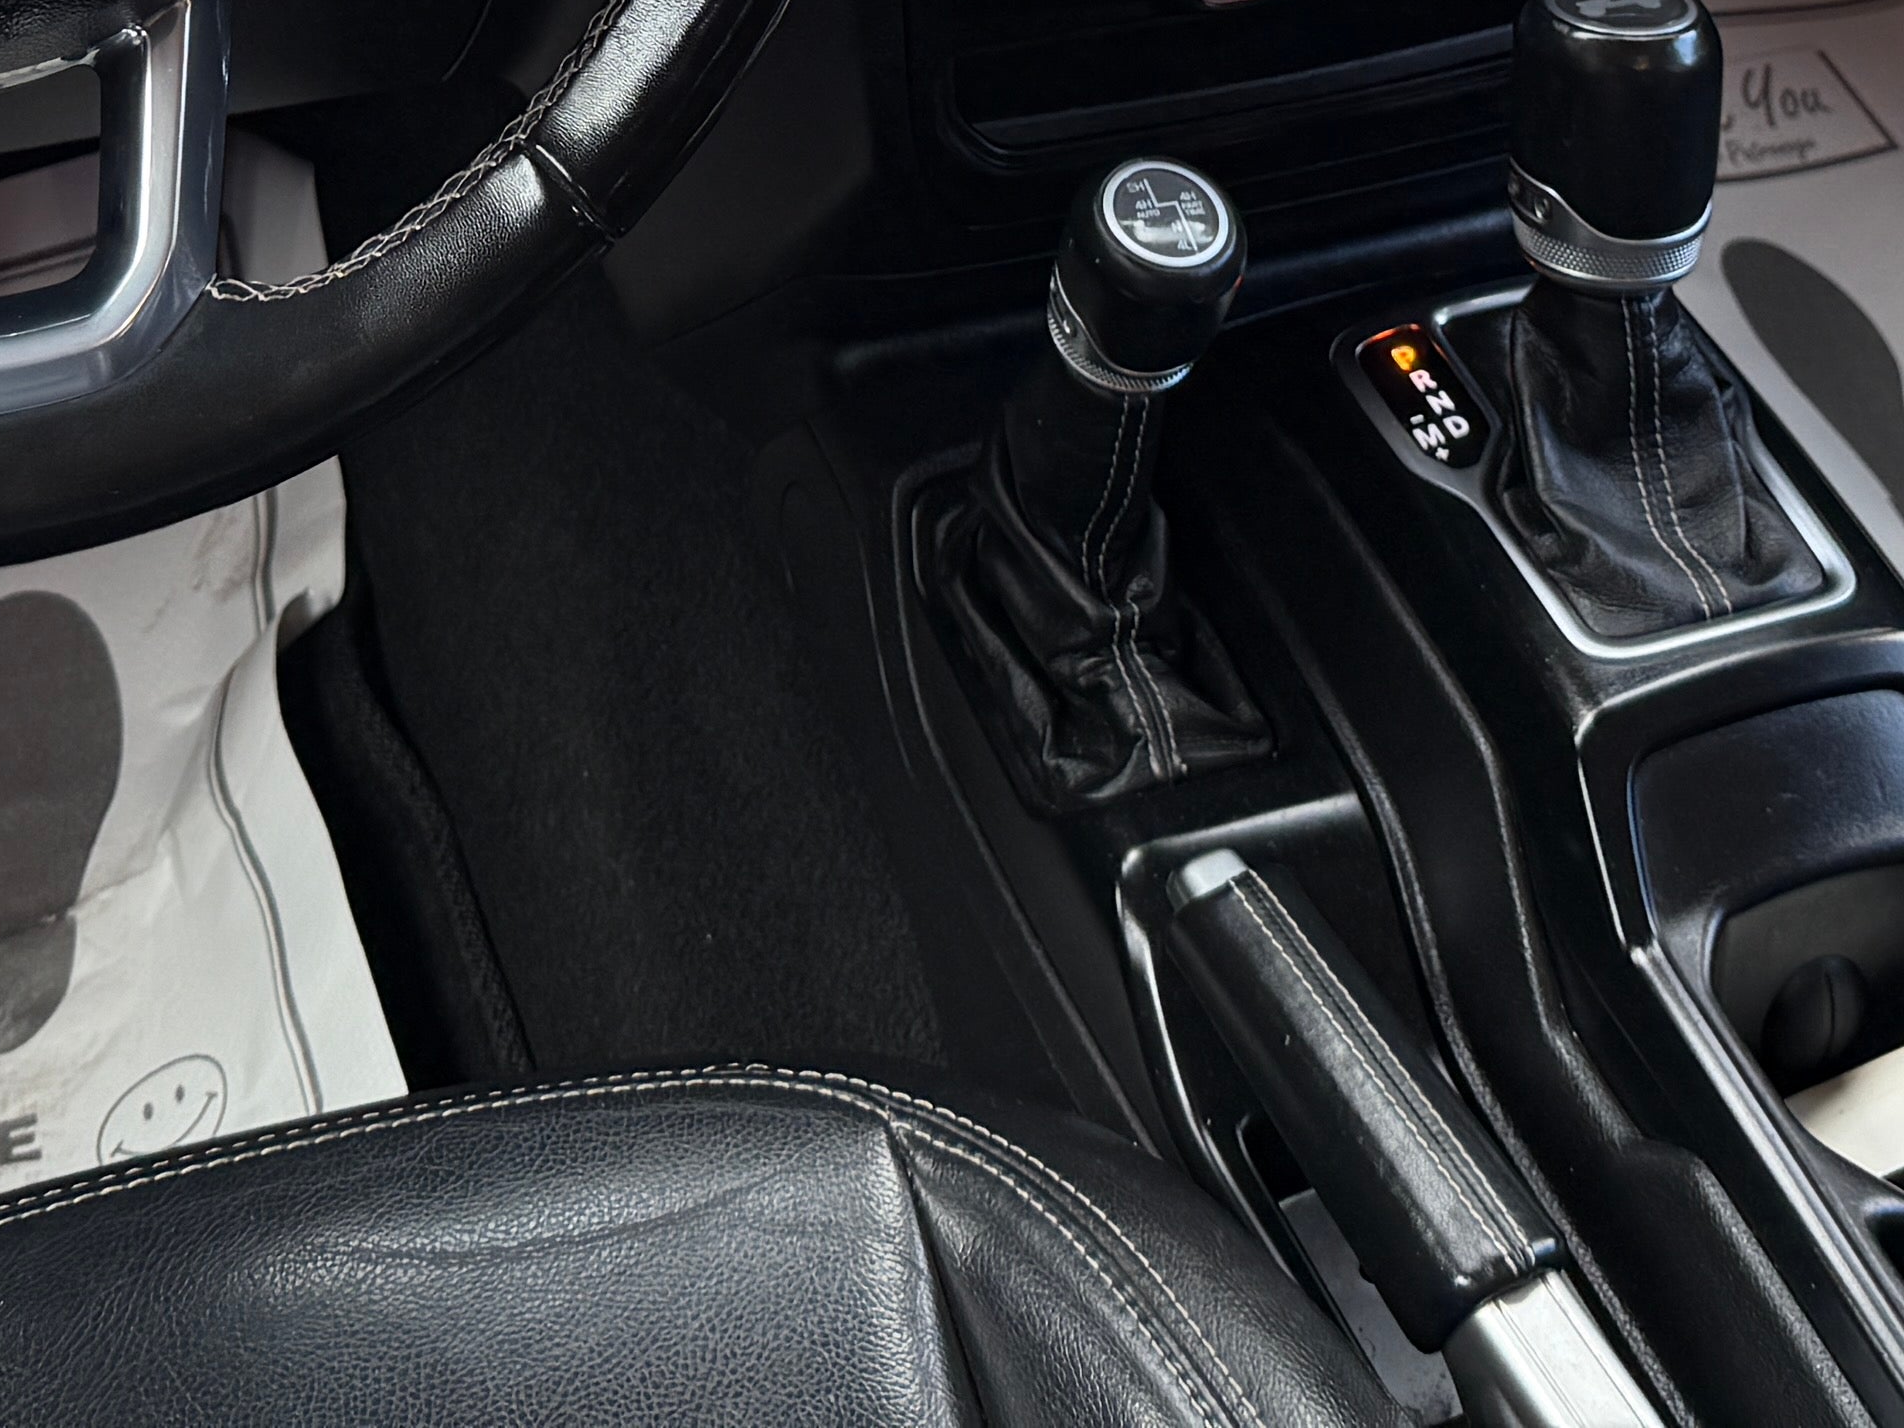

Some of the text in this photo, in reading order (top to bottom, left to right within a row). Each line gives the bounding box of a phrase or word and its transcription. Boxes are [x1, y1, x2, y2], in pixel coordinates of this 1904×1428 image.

[1391, 345, 1416, 372] P
[1409, 369, 1438, 393] R
[1425, 390, 1456, 416] N
[1412, 423, 1446, 451] M
[1443, 415, 1470, 439] D
